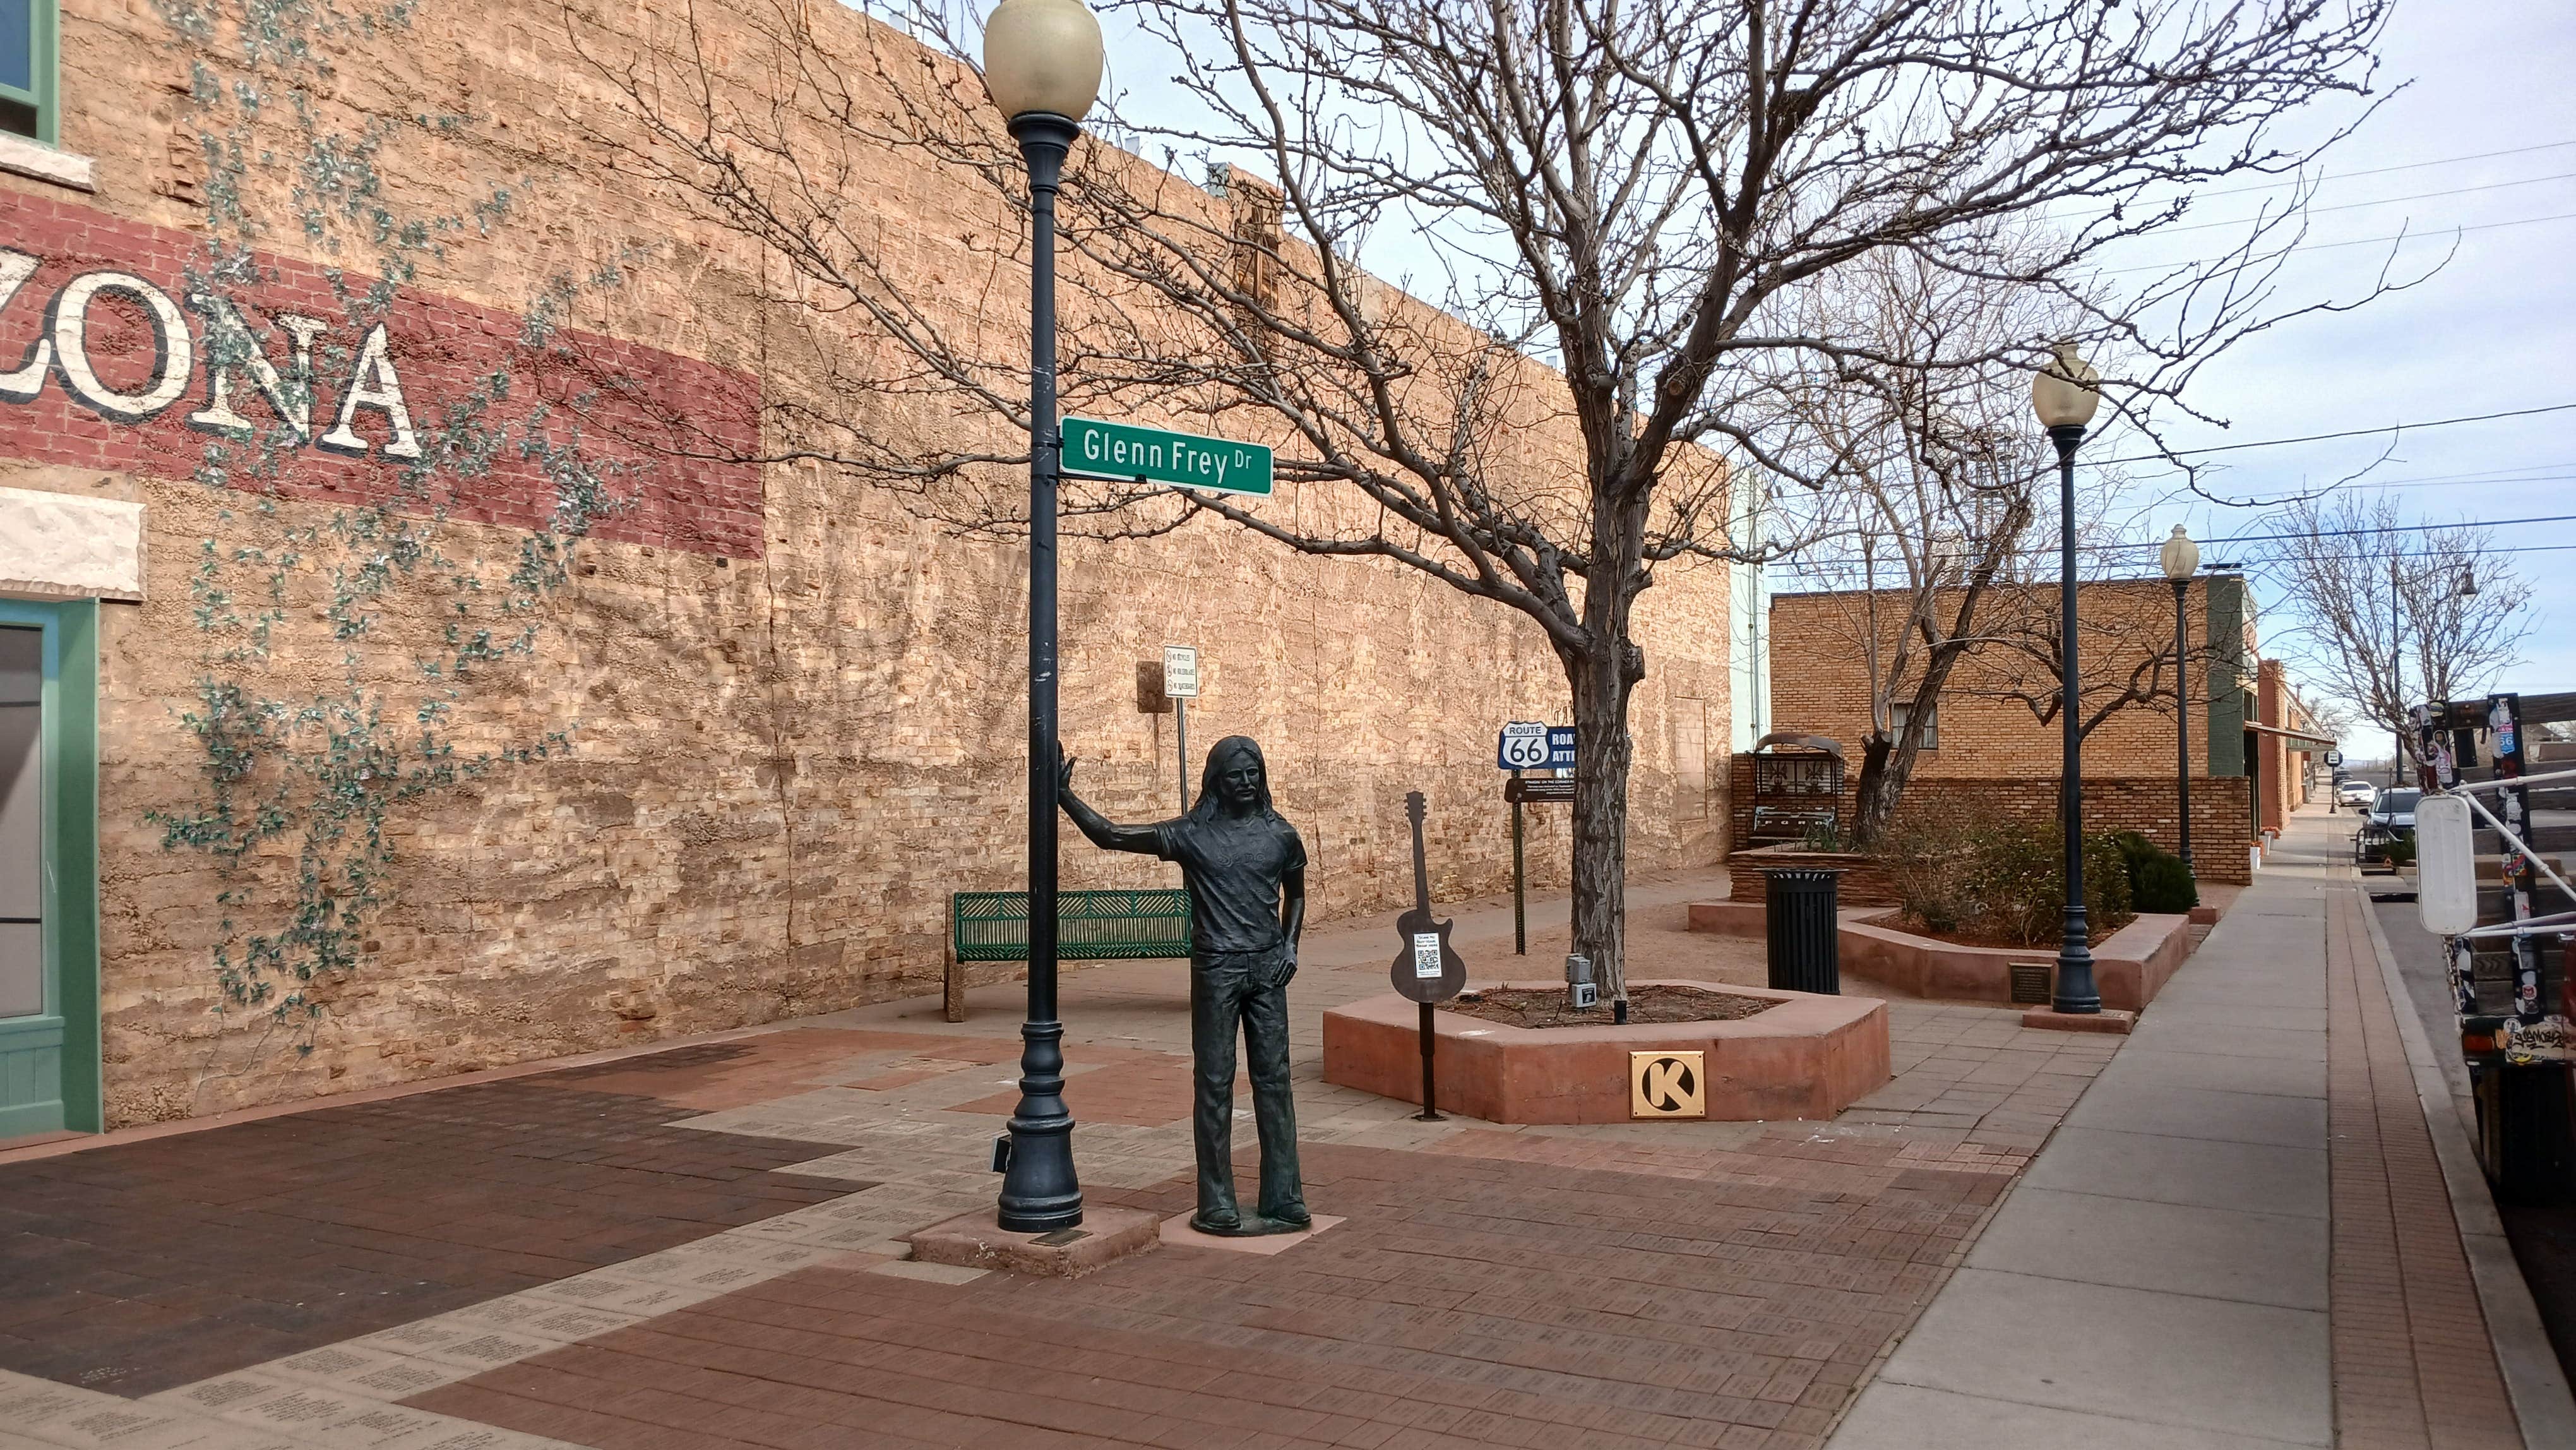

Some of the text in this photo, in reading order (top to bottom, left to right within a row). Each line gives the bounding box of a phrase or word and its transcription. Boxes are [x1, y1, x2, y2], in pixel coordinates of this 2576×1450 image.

[1083, 429, 1252, 484] Glenn Frey Dr
[1509, 726, 1541, 734] ROUTE
[1552, 733, 1575, 745] ROA
[1510, 738, 1542, 762] 66
[1649, 1060, 1693, 1110] K
